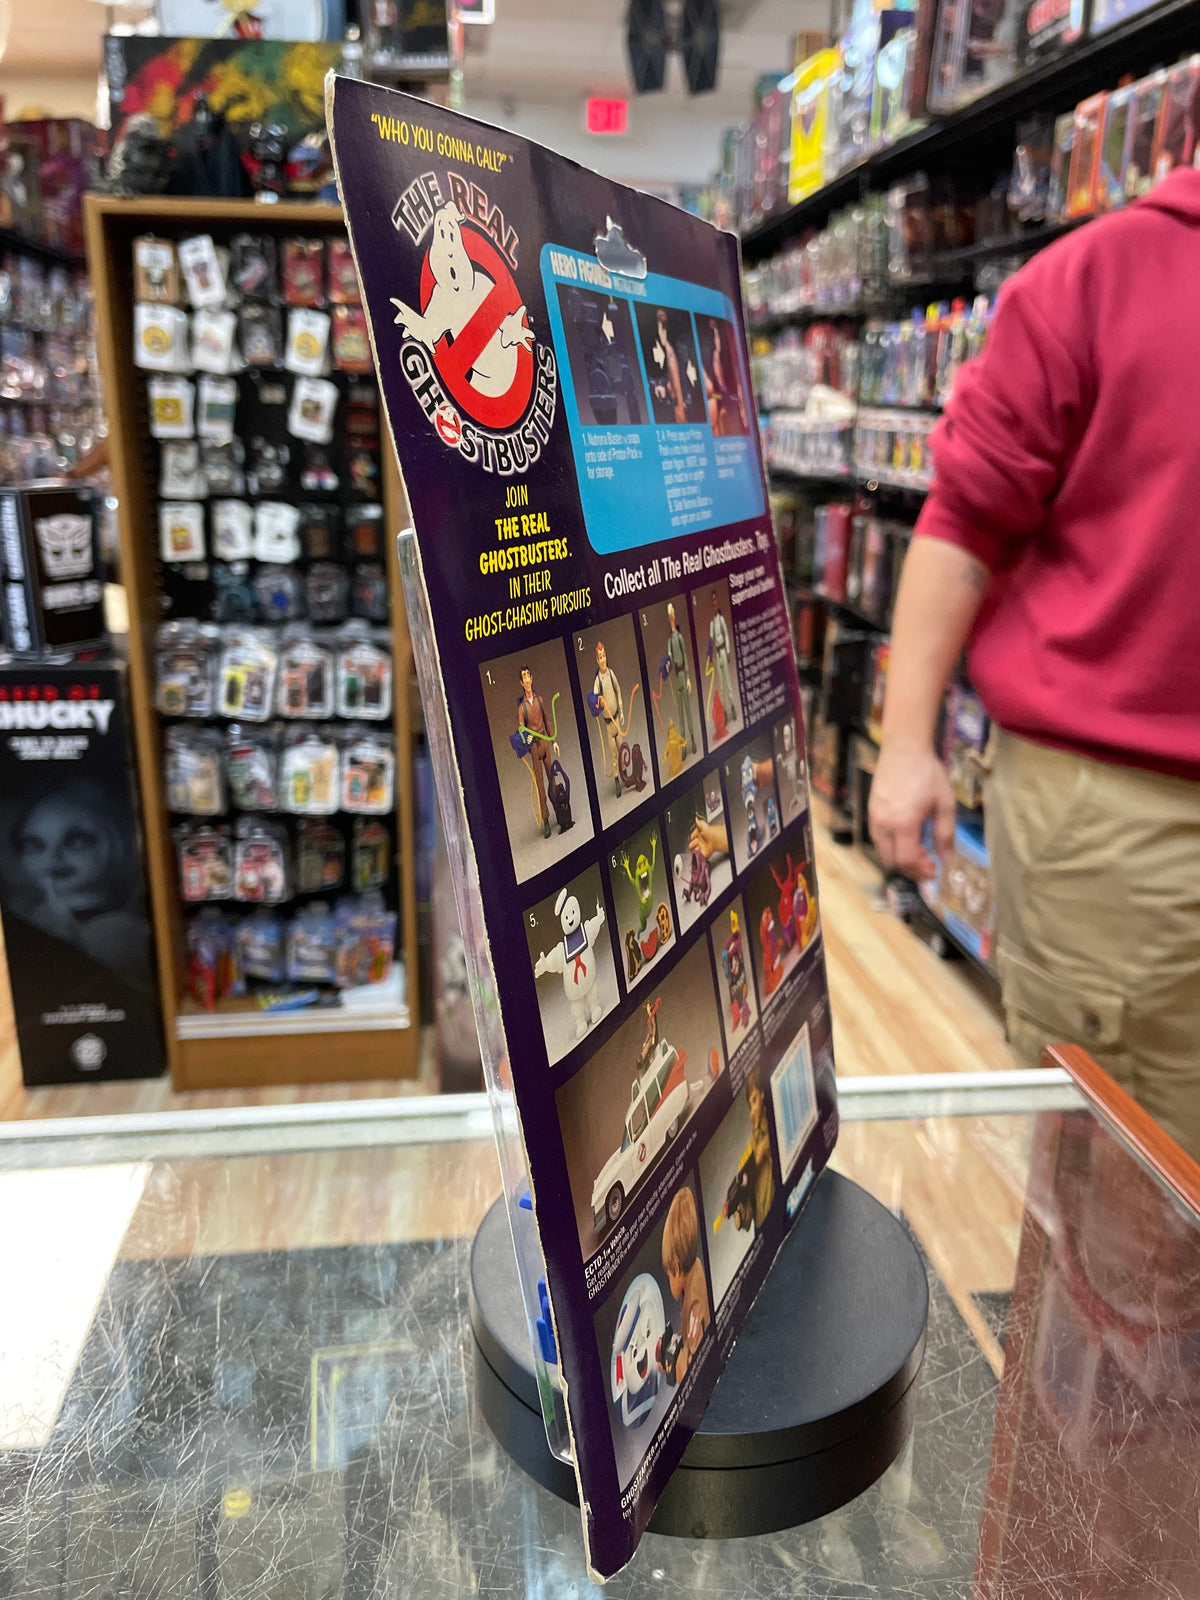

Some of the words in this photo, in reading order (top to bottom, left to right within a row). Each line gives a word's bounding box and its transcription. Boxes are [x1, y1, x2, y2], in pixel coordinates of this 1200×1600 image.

[411, 124, 434, 152] YOU
[437, 133, 475, 163] GONNA
[391, 171, 444, 247] THE
[447, 171, 519, 271] REAL
[549, 250, 577, 280] HERO
[505, 484, 529, 509] JOIN
[494, 516, 520, 541] THE
[520, 512, 551, 537] REAL
[509, 576, 521, 600] IN
[523, 569, 552, 596] THEIR
[604, 565, 647, 600] Collect
[647, 559, 662, 588] all
[661, 556, 682, 582] The
[682, 548, 703, 576] Real
[465, 599, 548, 642] GHOST-CHASING
[550, 586, 592, 617] PURSUITS
[486, 670, 496, 685] 1.
[529, 912, 539, 928] 5.
[586, 1274, 597, 1290] Get
